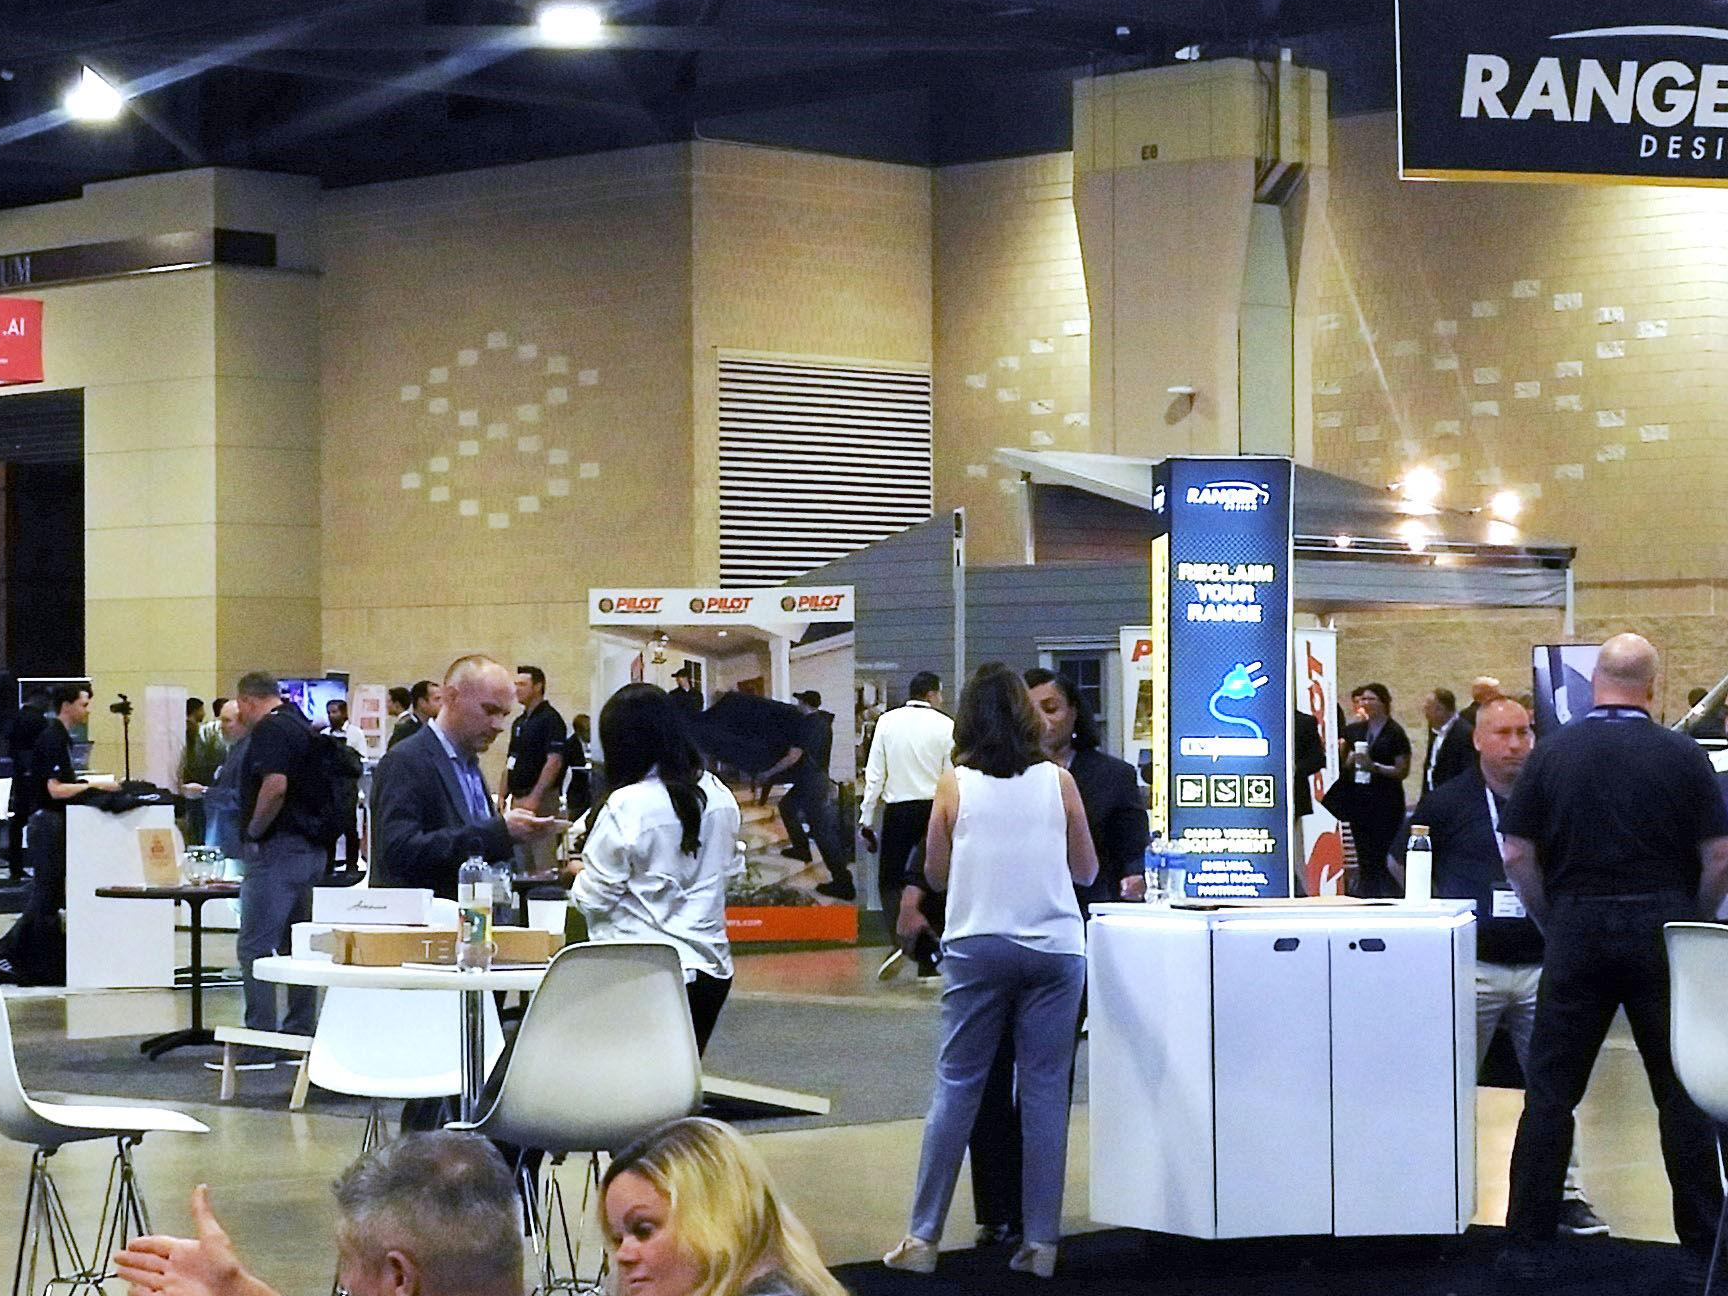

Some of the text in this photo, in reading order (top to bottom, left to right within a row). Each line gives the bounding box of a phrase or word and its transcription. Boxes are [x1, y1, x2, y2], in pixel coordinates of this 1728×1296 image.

[1177, 562, 1275, 583] RECLAIM
[797, 593, 845, 608] PILOT
[1194, 583, 1256, 603] YOUR
[616, 596, 664, 611] PILOT
[706, 596, 754, 610] PILOT
[1186, 603, 1264, 622] RANGE
